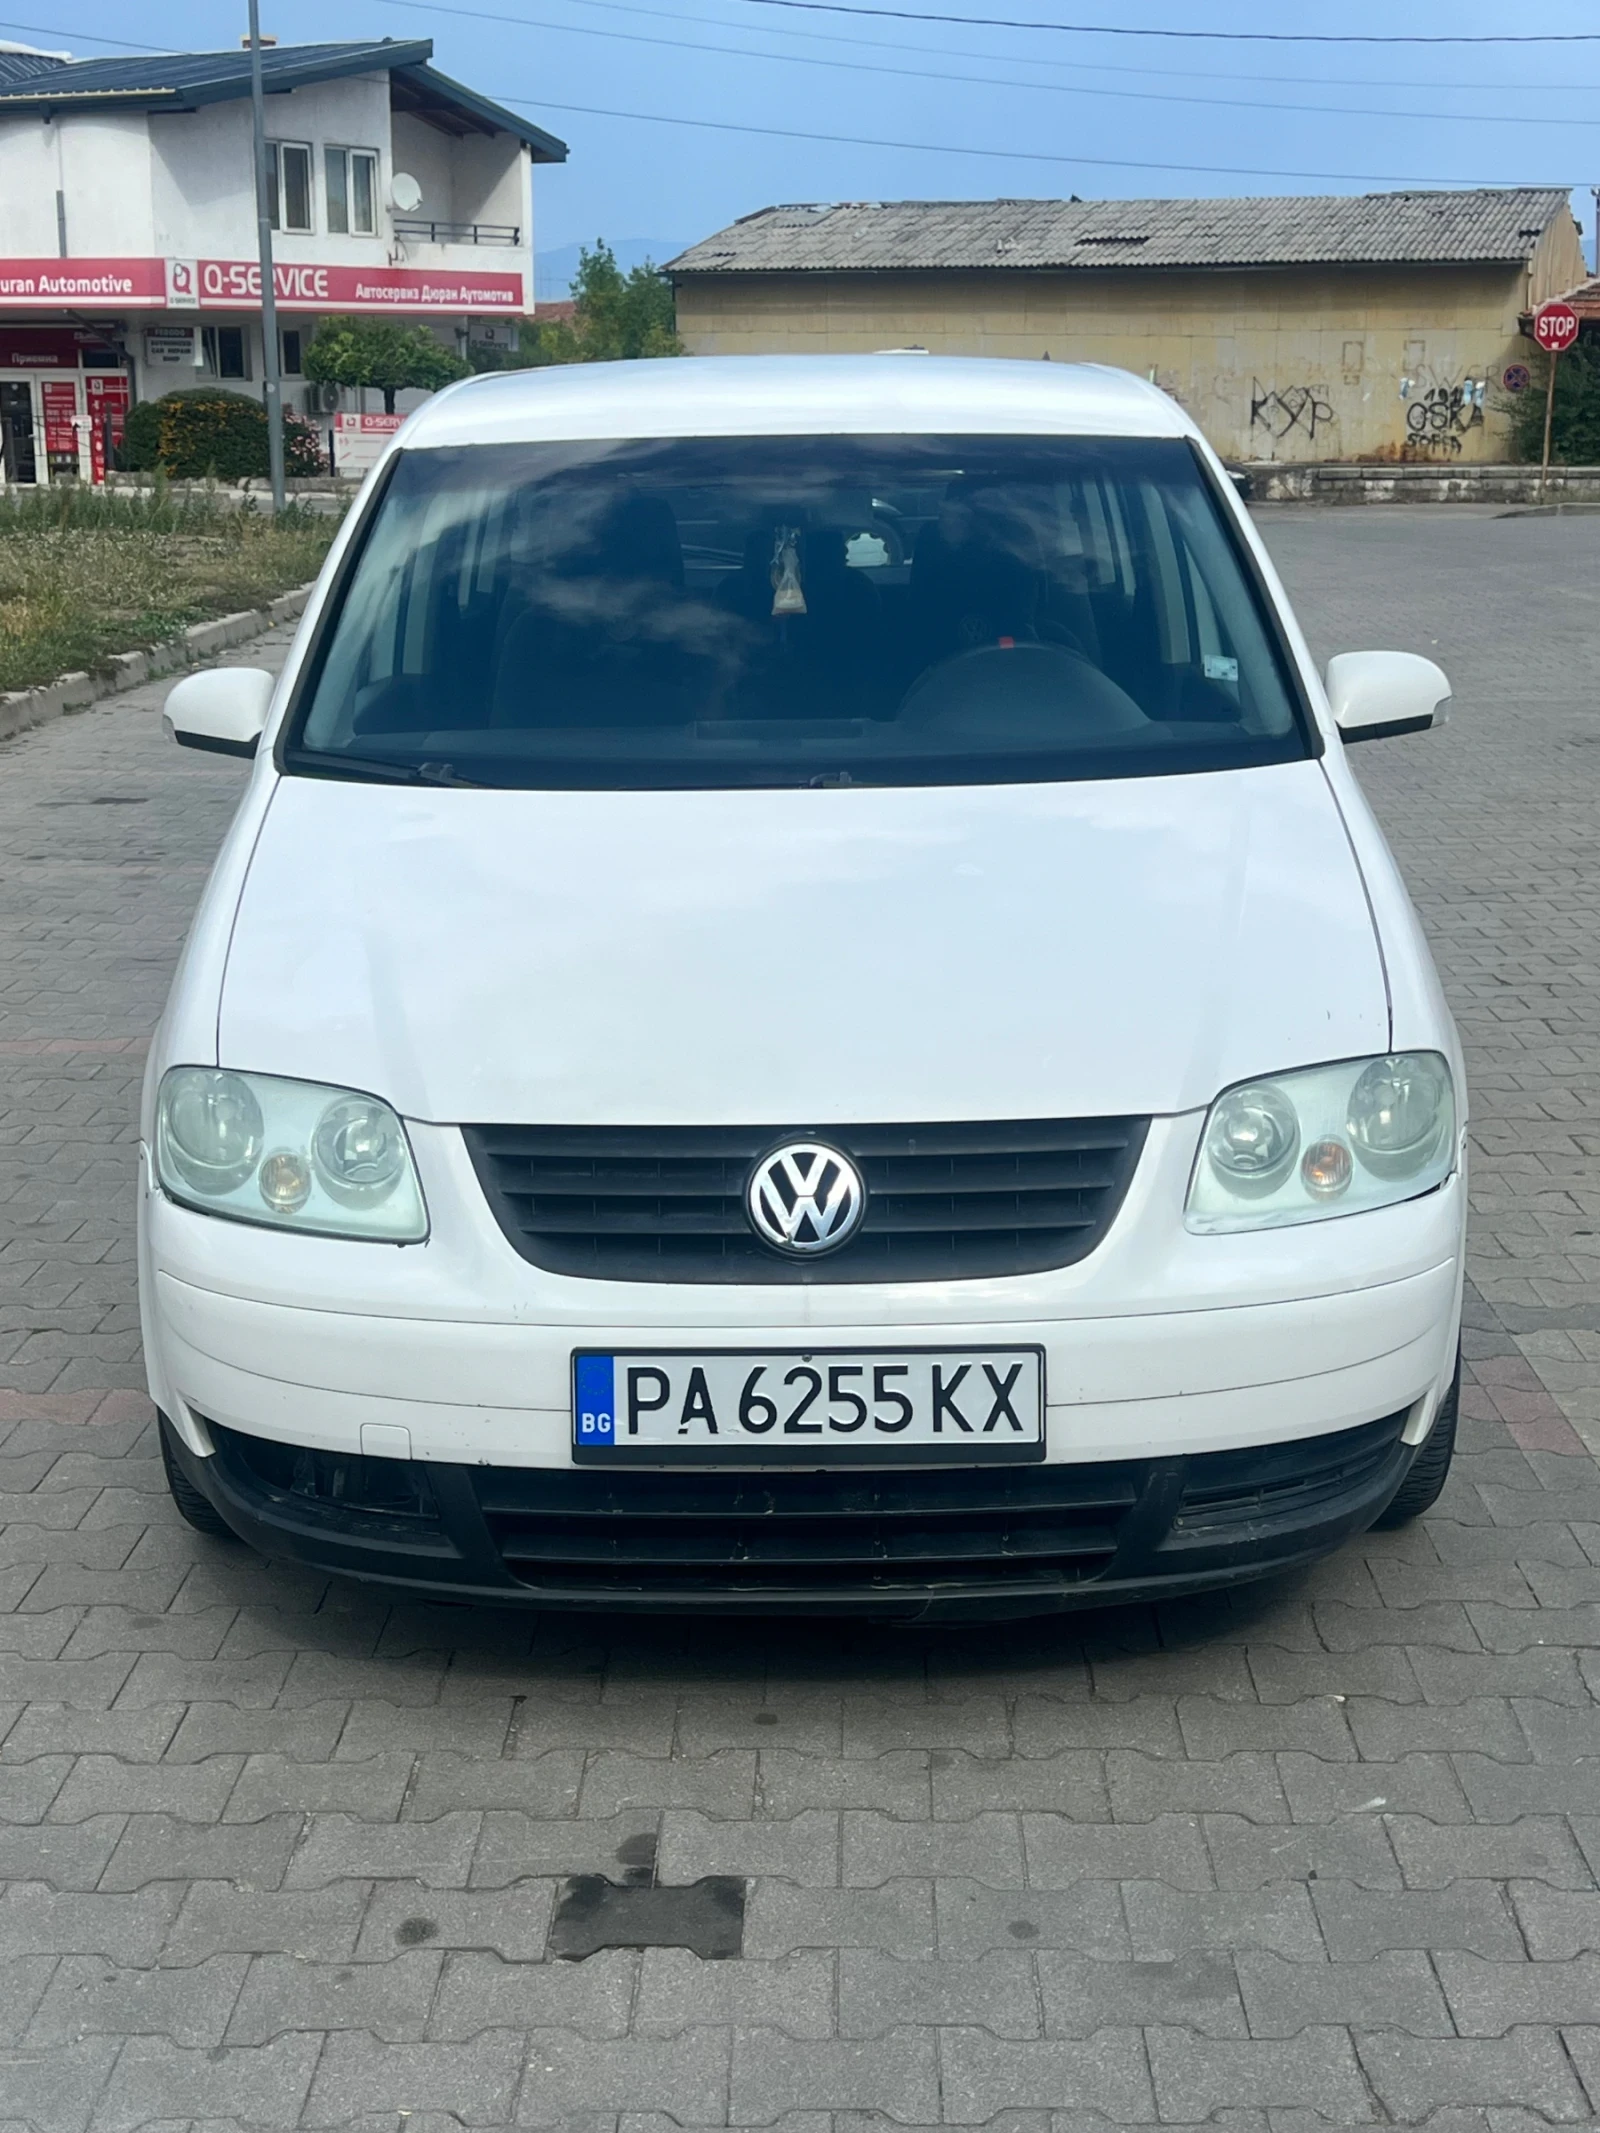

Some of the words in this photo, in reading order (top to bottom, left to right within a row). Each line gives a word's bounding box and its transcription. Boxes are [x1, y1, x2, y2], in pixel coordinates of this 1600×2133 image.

[0, 278, 35, 293] uran
[38, 274, 133, 293] Automotive
[355, 283, 419, 302] Автосервиз
[421, 284, 458, 303] Дюран
[459, 286, 514, 303] Аутомотив
[1538, 316, 1575, 337] STOP
[364, 416, 404, 428] Q-SERV
[626, 1366, 719, 1435] PA
[737, 1365, 914, 1434] 6255
[932, 1362, 1024, 1433] KX
[581, 1412, 611, 1433] BG
